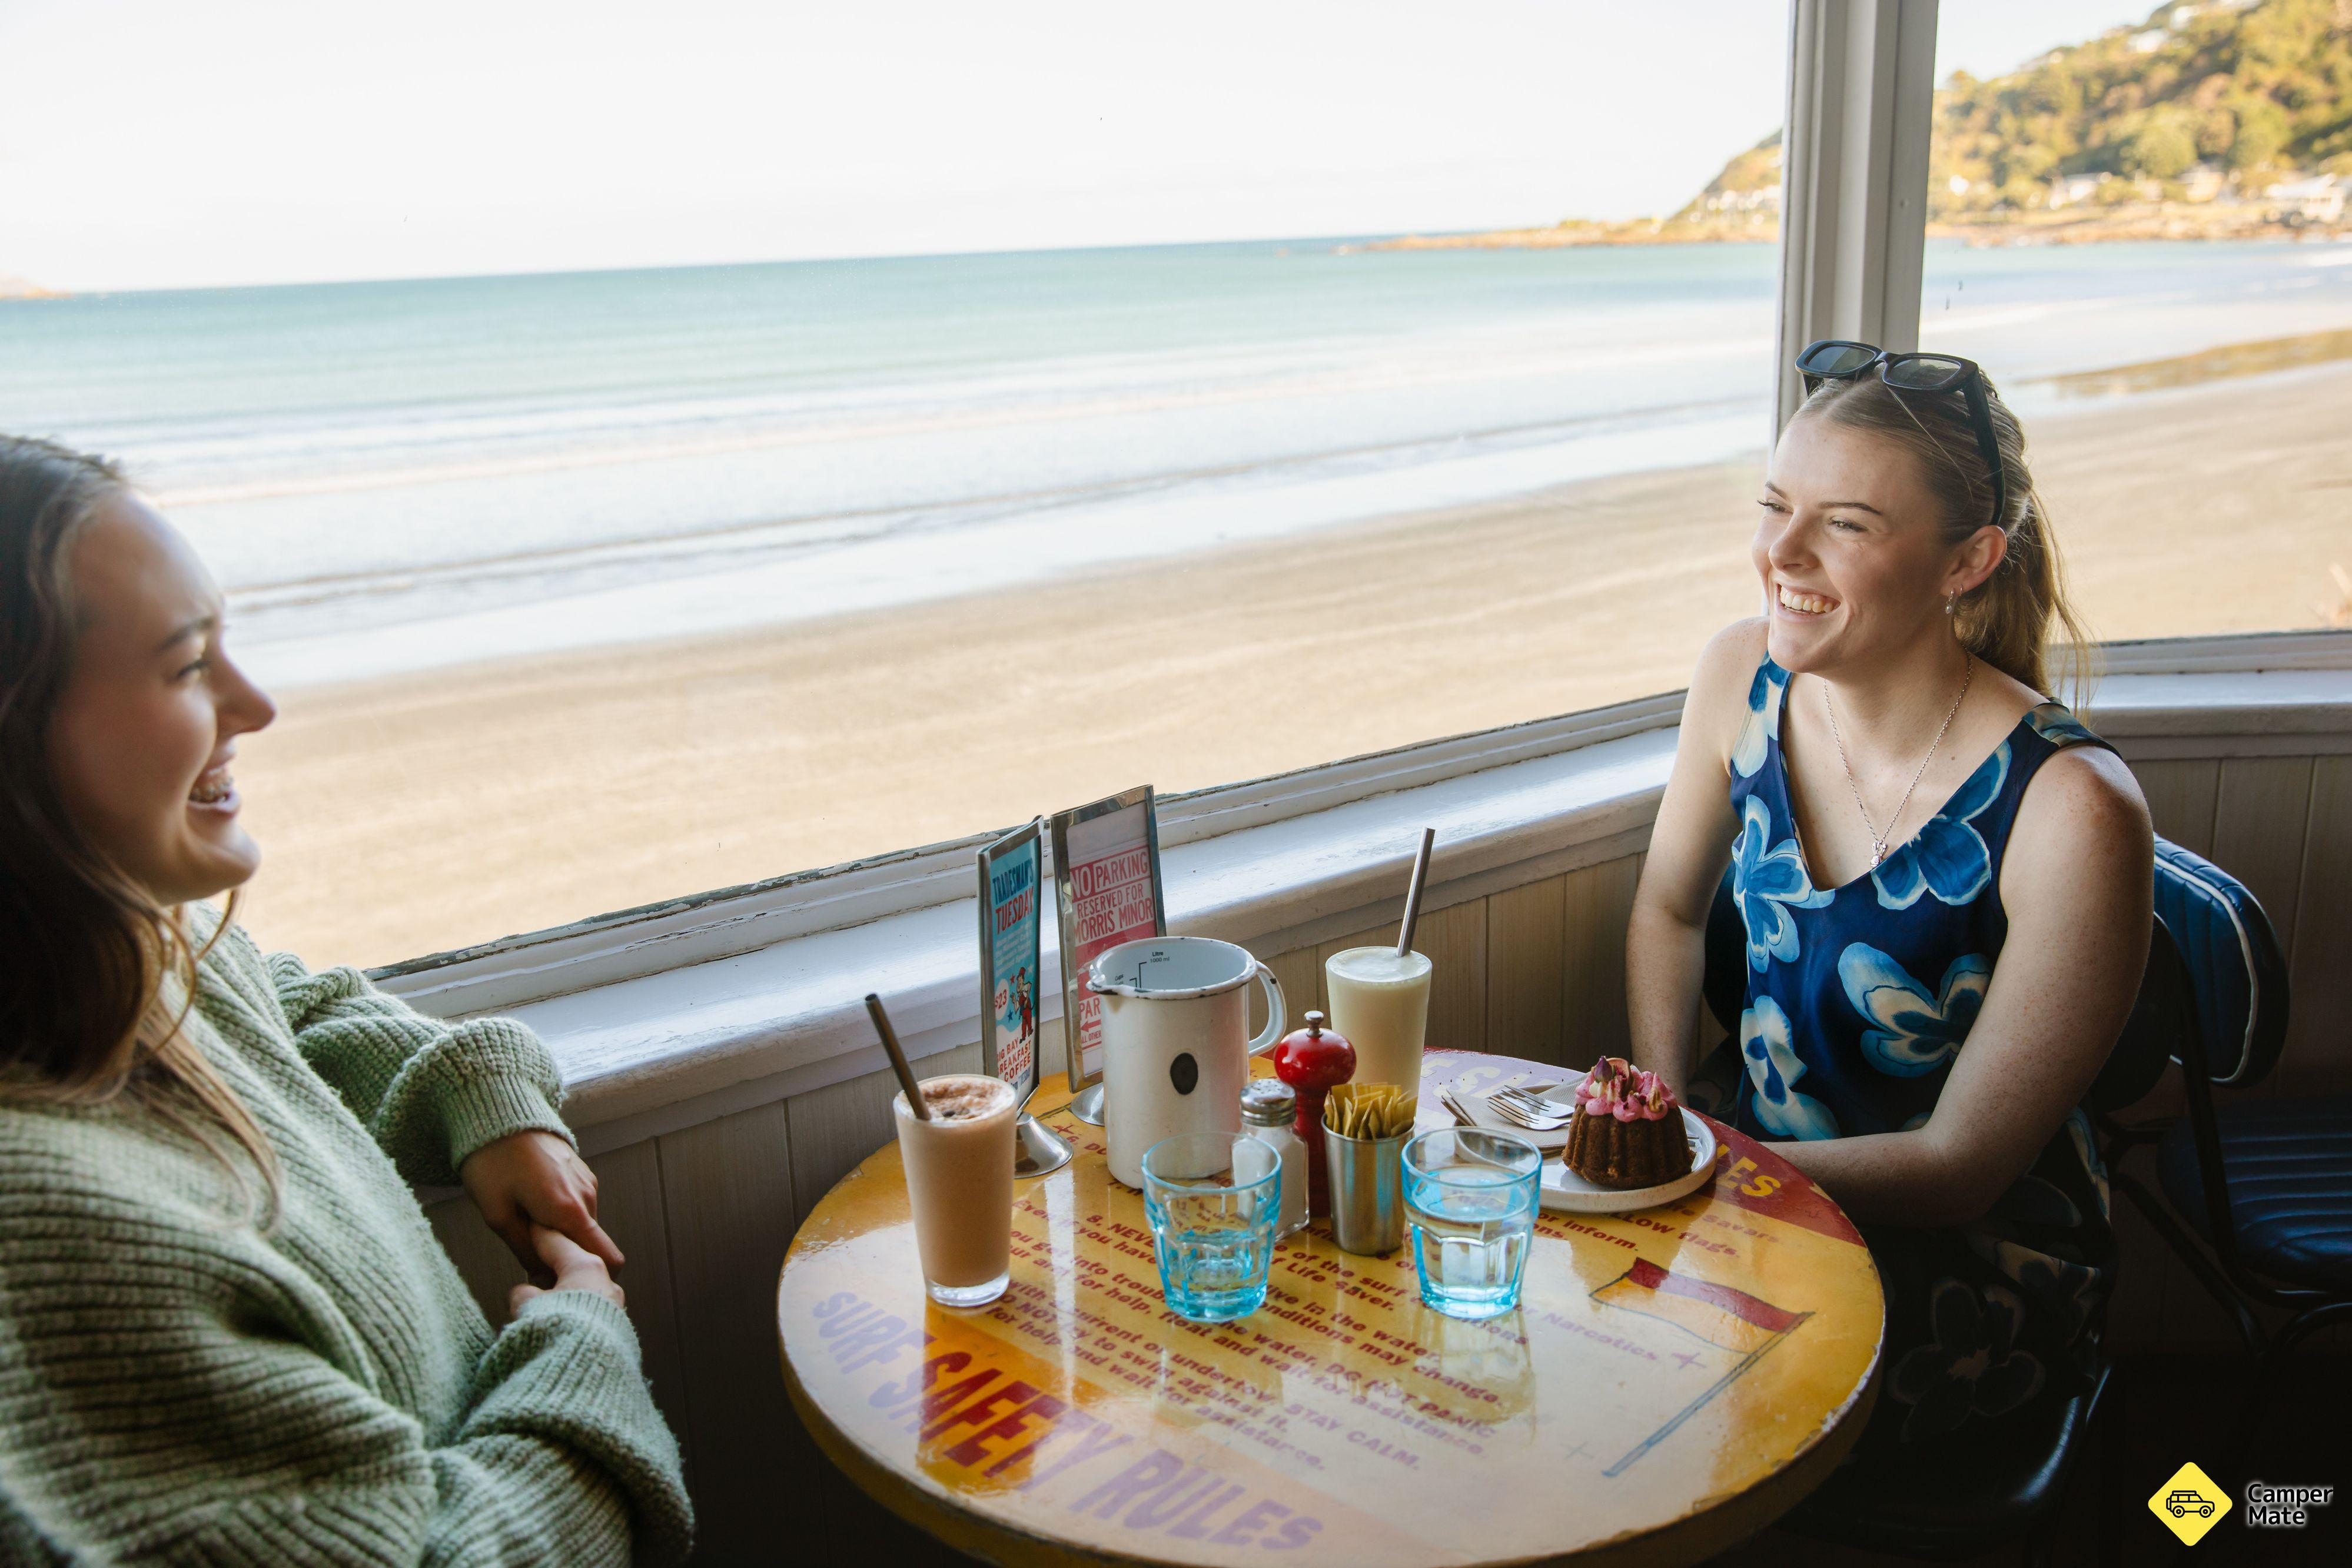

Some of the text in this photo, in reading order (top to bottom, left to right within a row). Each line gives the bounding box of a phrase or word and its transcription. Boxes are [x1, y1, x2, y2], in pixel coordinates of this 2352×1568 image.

[992, 858, 1034, 905] TRADESMAN'S
[1070, 851, 1148, 899] NO PARKING
[995, 885, 1034, 935] TUESDAY
[1074, 898, 1153, 942] MORRIS MINOR
[1077, 883, 1144, 918] RESERVED FOR
[999, 1039, 1031, 1075] REAKFAST
[1004, 1052, 1031, 1082] COFFEE
[1007, 1037, 1018, 1054] BAY
[1563, 1220, 1639, 1251] inform.
[1609, 1211, 1676, 1234] LLOW
[1086, 1214, 1104, 1226] 8.
[1107, 1223, 1154, 1248] NEVE
[1330, 1312, 1366, 1331] the
[1286, 1262, 1326, 1282] Life
[1335, 1281, 1394, 1311] Saver.
[1292, 1252, 1320, 1263] of
[1320, 1260, 1355, 1277] the
[1359, 1277, 1410, 1297] surf
[1011, 1230, 1034, 1243] ou
[1070, 1255, 1108, 1275] into
[1112, 1273, 1165, 1303] troub
[1326, 1363, 1363, 1381] DO
[1364, 1380, 1417, 1404] NOT
[1418, 1403, 1497, 1438] PANIC
[1074, 1227, 1112, 1244] you
[1113, 1241, 1157, 1264] have
[1358, 1343, 1410, 1366] may
[1413, 1365, 1504, 1407] change.
[1074, 1274, 1105, 1290] for
[1105, 1287, 1151, 1314] help,
[1158, 1311, 1212, 1337] float
[1213, 1336, 1259, 1356] and
[1260, 1355, 1310, 1379] wait
[1313, 1376, 1350, 1395] for
[1542, 1312, 1657, 1360] Narcotics
[985, 1306, 1018, 1324] for
[1016, 1321, 1062, 1346] help
[1108, 1364, 1157, 1389] wait
[1159, 1386, 1194, 1405] for
[1009, 1280, 1047, 1301] with
[1144, 1342, 1165, 1354] or
[1285, 1403, 1344, 1432] STAY
[1346, 1431, 1420, 1470] CALM.
[1015, 1301, 1062, 1323] NOT
[1093, 1337, 1117, 1351] to
[1119, 1351, 1176, 1378] swim
[1178, 1378, 1264, 1417] against
[812, 1290, 1324, 1551] SURF SAFETY RULES
